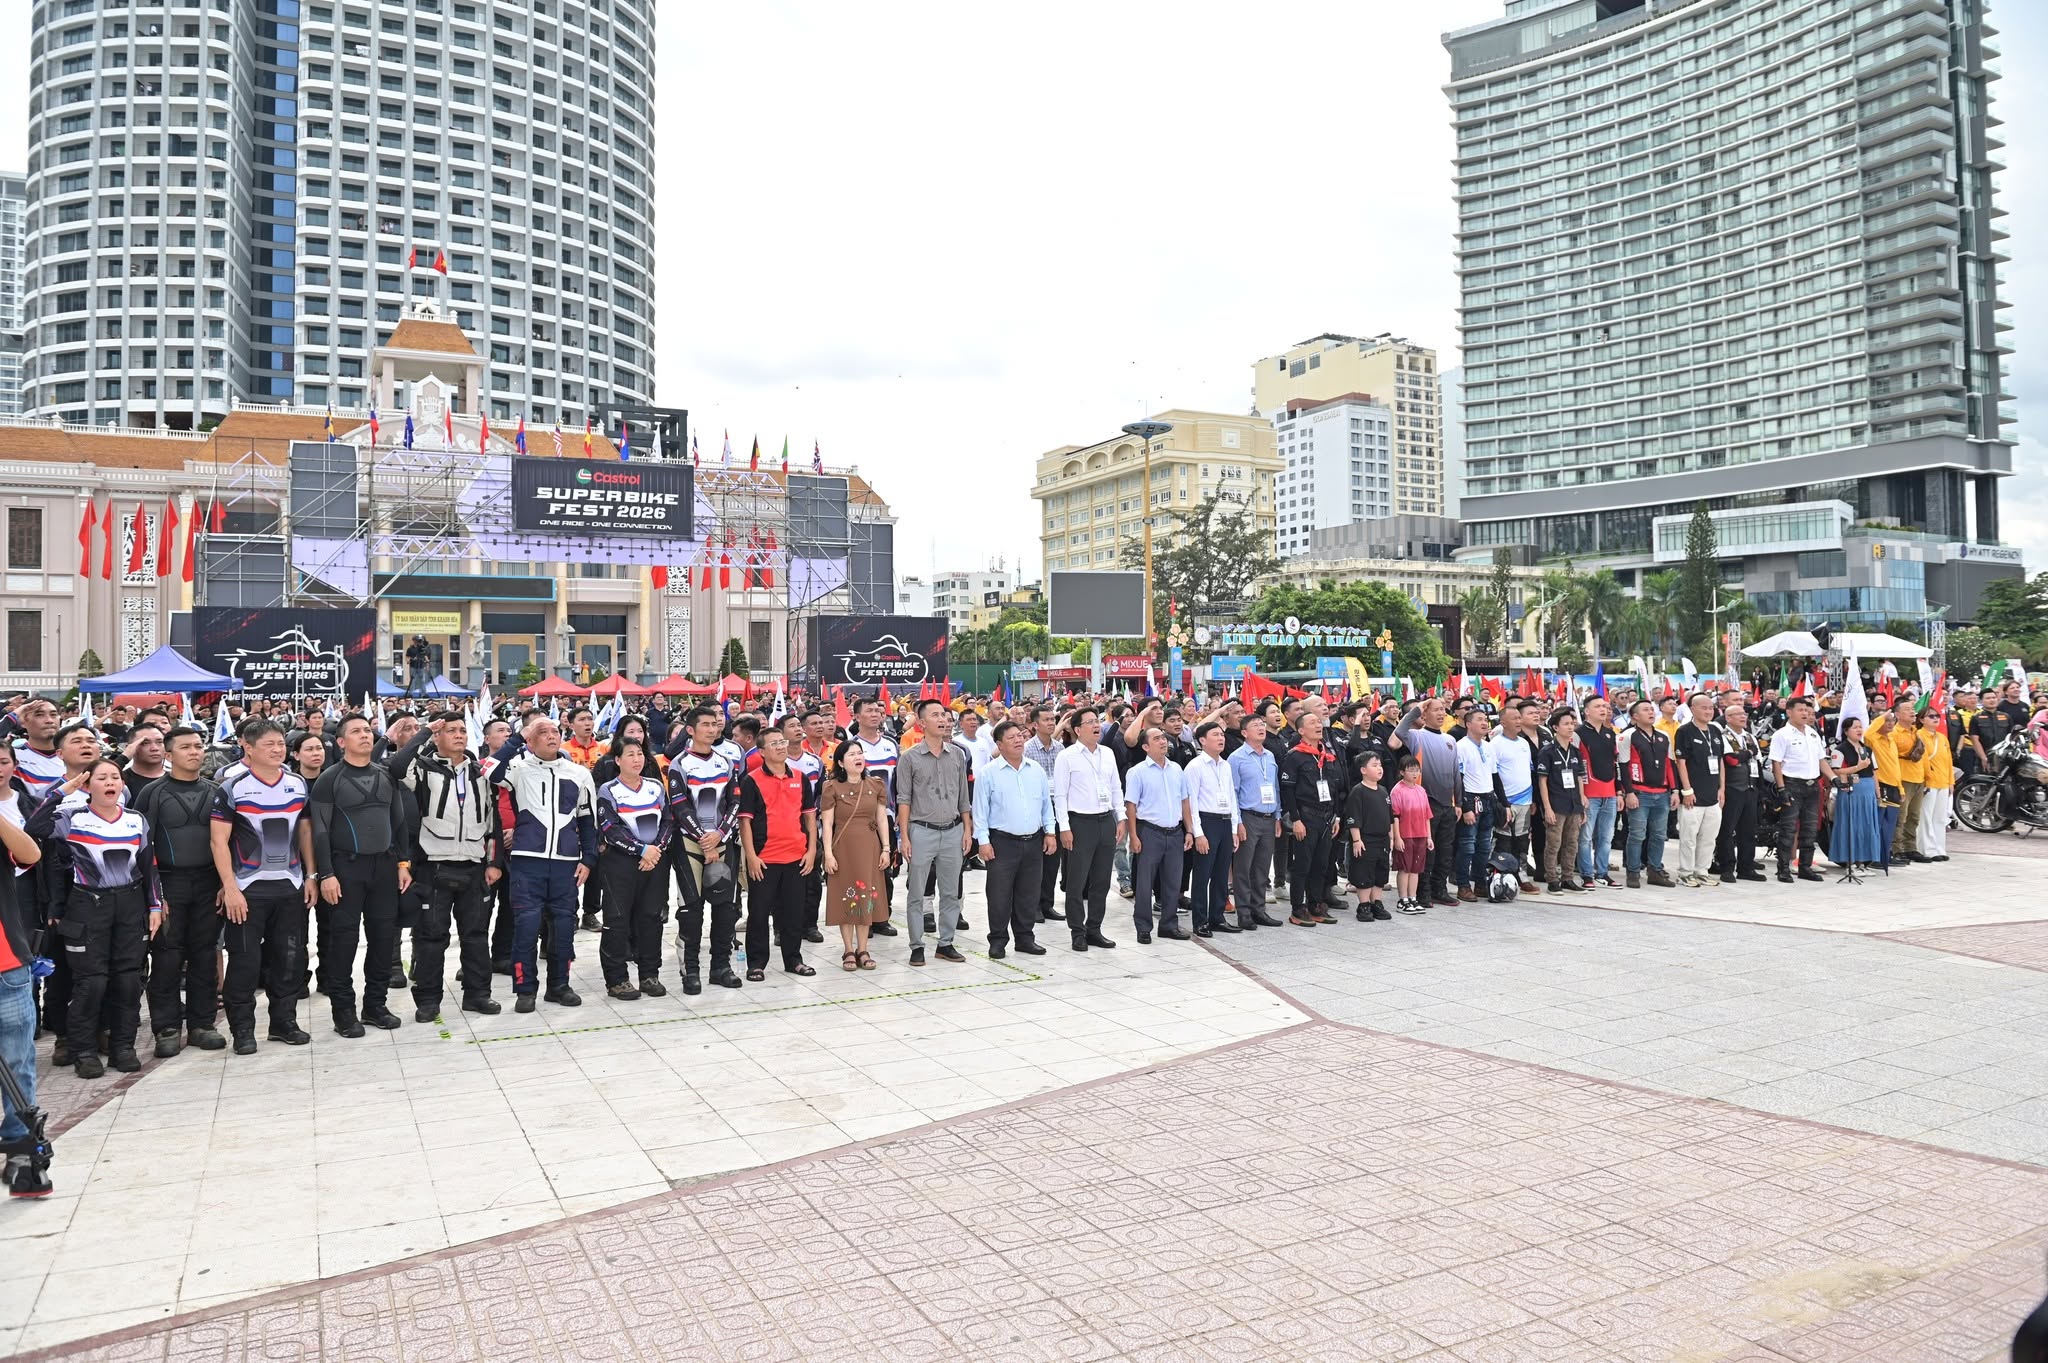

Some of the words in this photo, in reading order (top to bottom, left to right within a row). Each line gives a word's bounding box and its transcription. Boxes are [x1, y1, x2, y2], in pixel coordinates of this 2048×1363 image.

[593, 471, 640, 485] Castrol
[532, 487, 679, 505] SUPERBIKE
[547, 502, 613, 517] FEST
[616, 505, 667, 520] 2026
[613, 522, 673, 531] CONNECTION
[1969, 547, 1990, 557] HYATT
[1991, 549, 2020, 560] REGENCY
[1222, 628, 1256, 645] KÍNH
[1261, 630, 1295, 646] CHÀO
[1326, 631, 1368, 647] KHÁCH
[244, 662, 337, 670] SUPERBIKE
[1120, 660, 1149, 668] MIXUE
[296, 672, 329, 680] 2026
